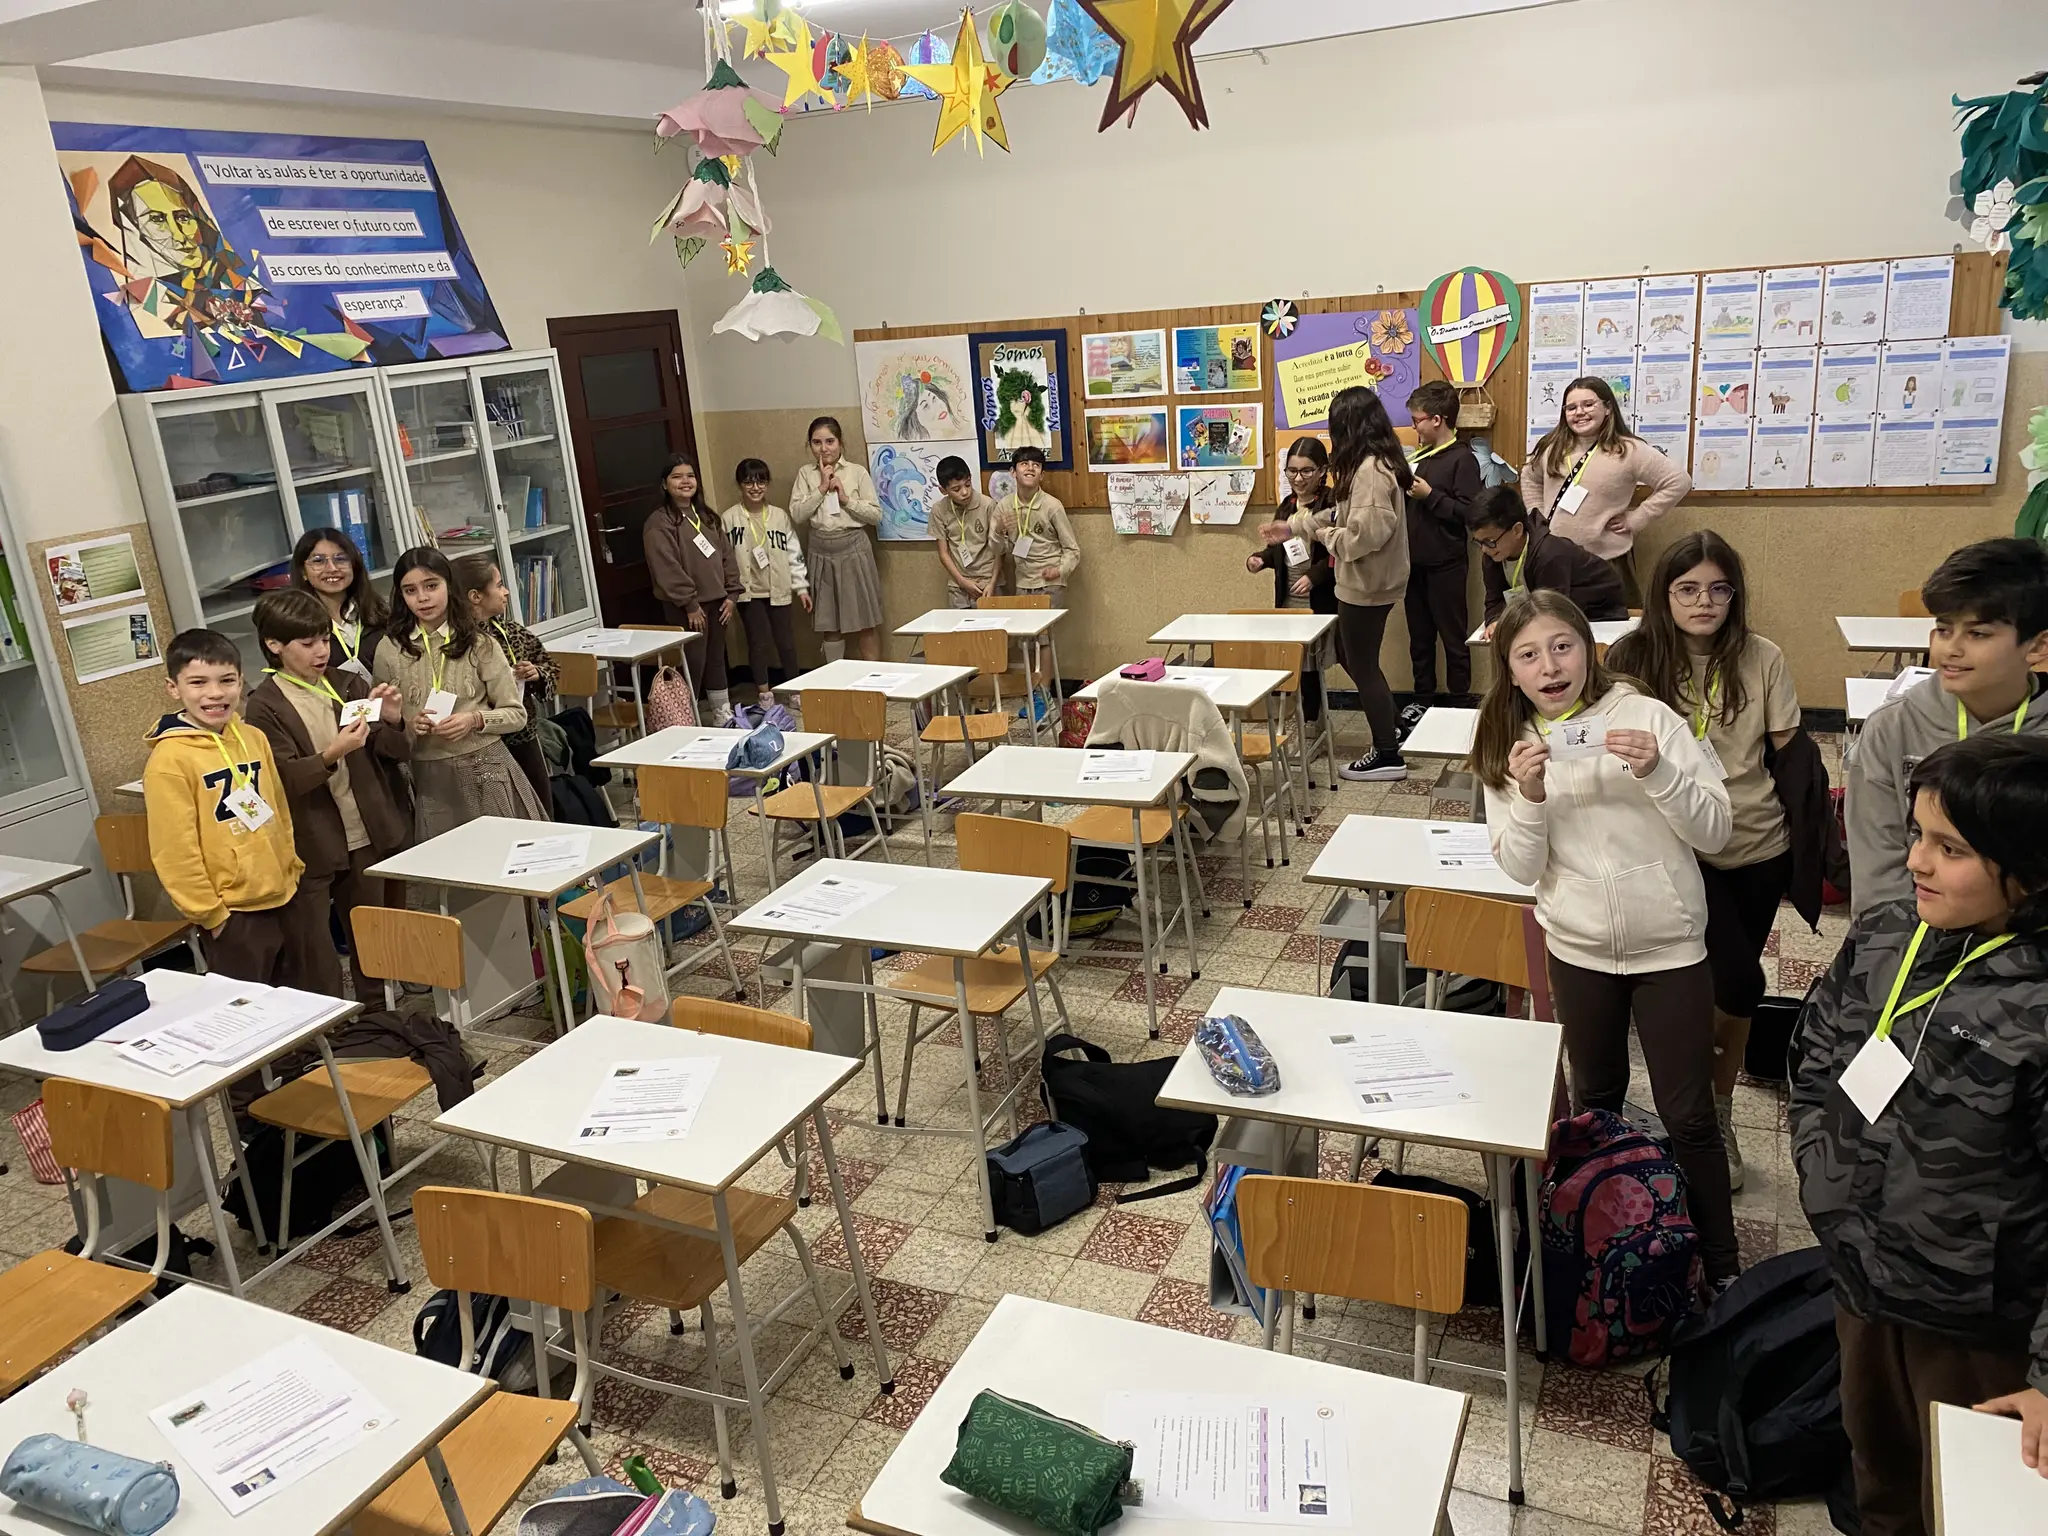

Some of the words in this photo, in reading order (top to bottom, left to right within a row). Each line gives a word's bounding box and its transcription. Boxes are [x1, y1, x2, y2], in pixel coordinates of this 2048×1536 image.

[255, 164, 272, 179] às
[273, 164, 307, 179] aulas
[308, 165, 318, 179] é
[318, 167, 337, 180] ter
[339, 170, 348, 180] a
[350, 169, 427, 183] oportunidade
[268, 216, 286, 230] de
[288, 219, 339, 231] escrever
[343, 220, 352, 230] o
[353, 218, 391, 232] futuro
[392, 221, 418, 232] com
[270, 265, 285, 277] as
[287, 264, 322, 276] cores
[324, 262, 341, 276] do
[344, 261, 426, 277] conhecimento
[428, 262, 436, 272] e
[436, 259, 451, 272] da
[993, 344, 1043, 362] Somos
[1292, 356, 1323, 371] Acreditar
[1336, 348, 1353, 360] força
[1293, 374, 1304, 383] Que
[1305, 372, 1315, 380] nos
[1315, 367, 1337, 379] permite
[1337, 363, 1352, 372] subir
[1296, 386, 1305, 394] Os
[1307, 380, 1333, 391] maiores
[1334, 374, 1363, 385] degraus
[982, 376, 997, 430] Somos
[1046, 371, 1060, 431] Natureza
[1297, 396, 1307, 406] Na
[1307, 391, 1330, 403] escada
[1330, 389, 1339, 398] da
